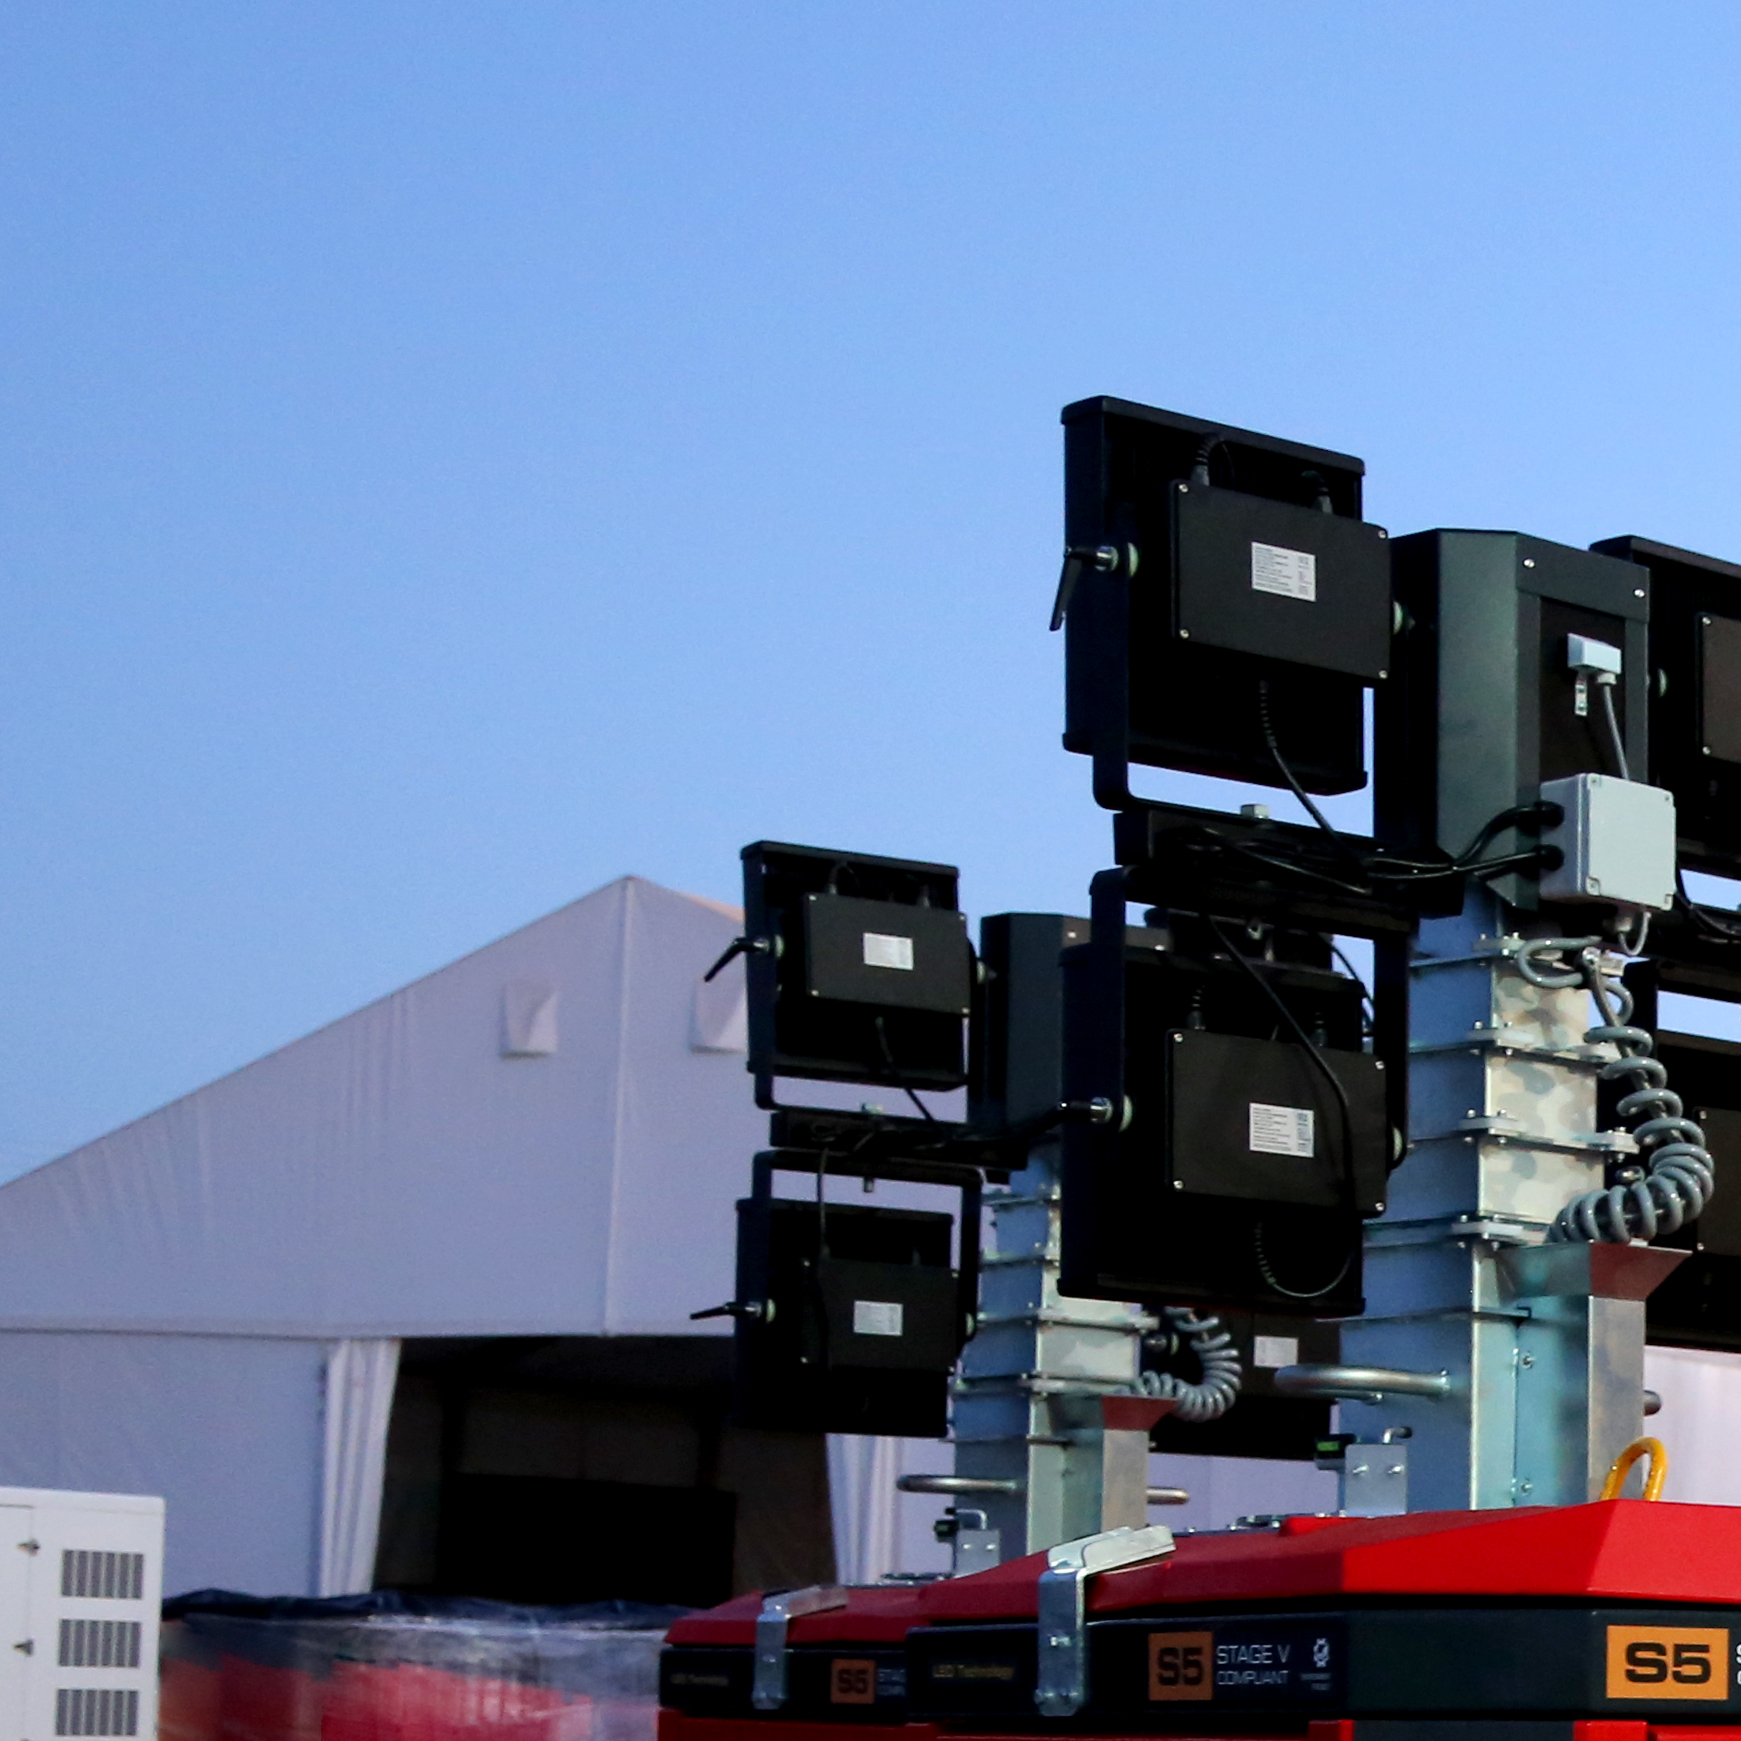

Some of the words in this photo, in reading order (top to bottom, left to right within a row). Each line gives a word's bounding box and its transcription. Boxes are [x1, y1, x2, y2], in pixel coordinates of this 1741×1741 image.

[1156, 1646, 1205, 1687] S5
[1216, 1644, 1273, 1665] STAGE
[1277, 1644, 1291, 1664] V
[1624, 1641, 1712, 1685] S5
[837, 1668, 869, 1694] S5
[1216, 1669, 1290, 1686] COMPLIANT
